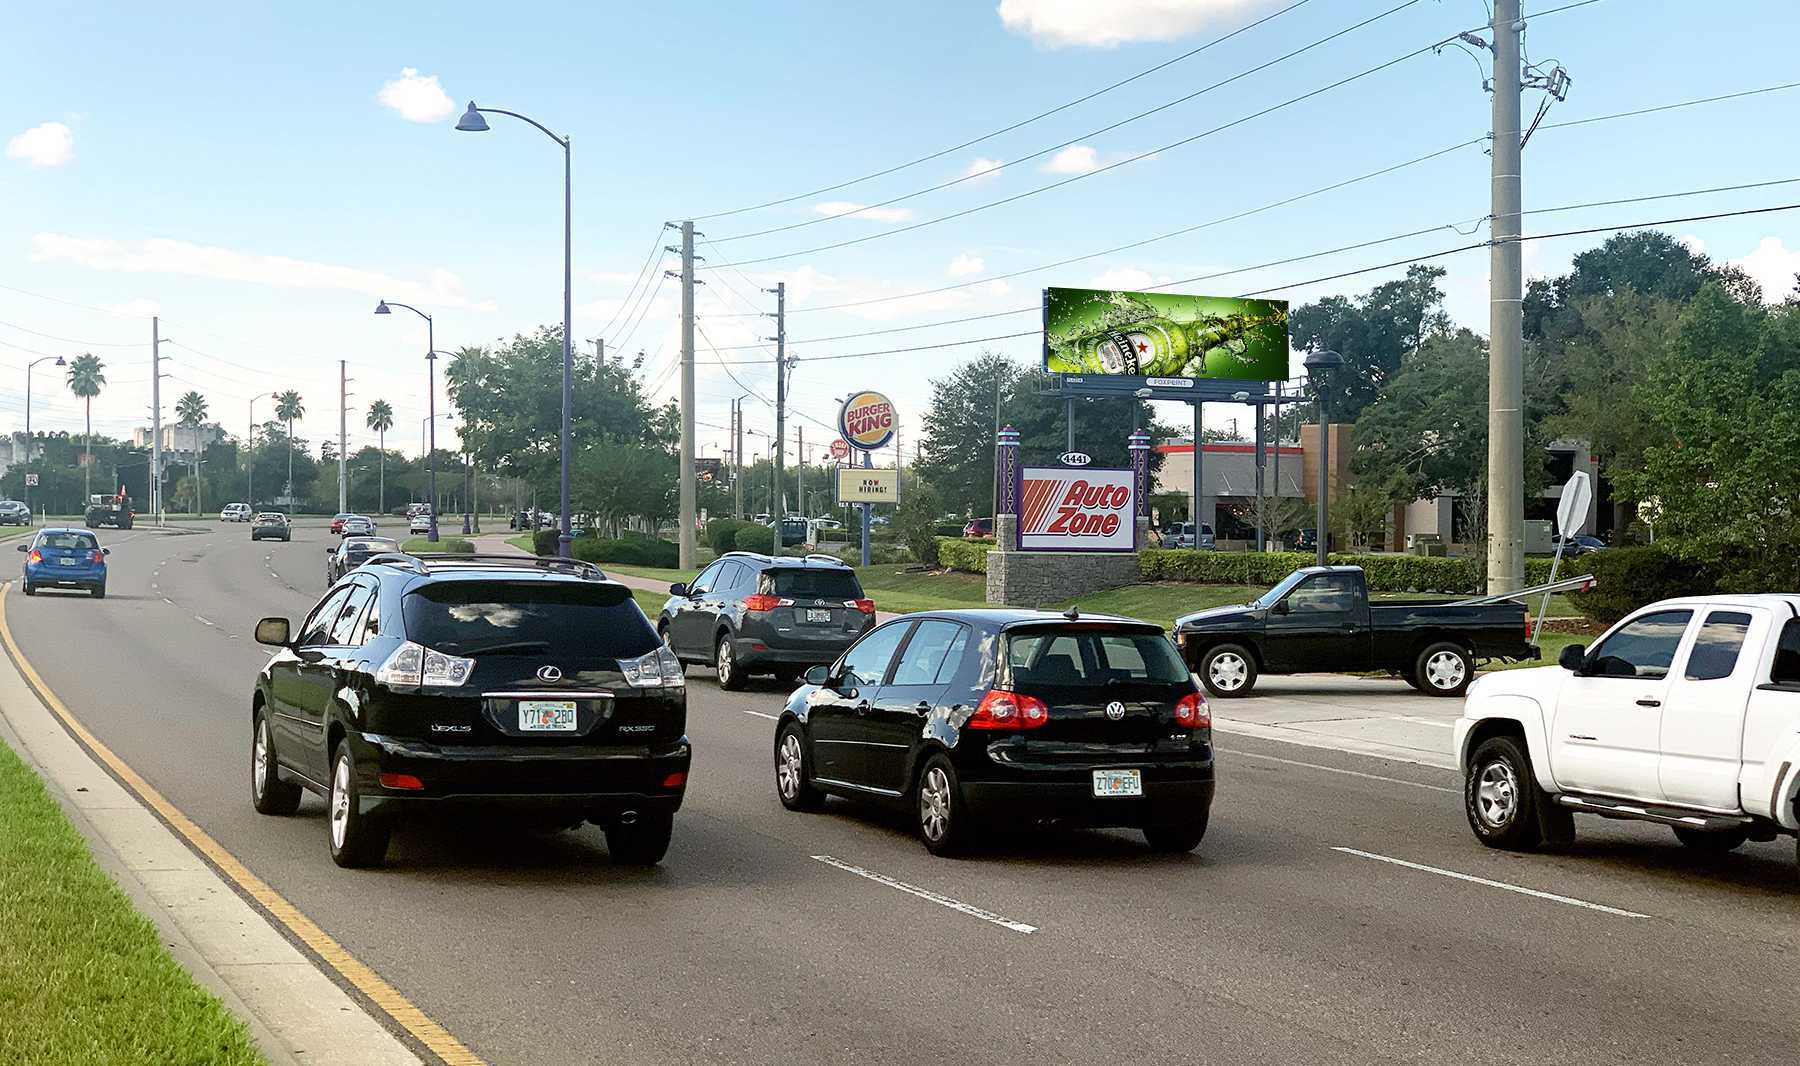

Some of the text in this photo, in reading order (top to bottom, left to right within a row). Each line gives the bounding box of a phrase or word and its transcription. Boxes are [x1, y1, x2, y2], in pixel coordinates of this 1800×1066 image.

[847, 403, 890, 422] BURGER
[848, 414, 892, 437] KING
[1063, 455, 1088, 464] 4441
[1061, 479, 1130, 509] Auto
[1047, 507, 1121, 536] Zone
[431, 724, 472, 732] LEXUS
